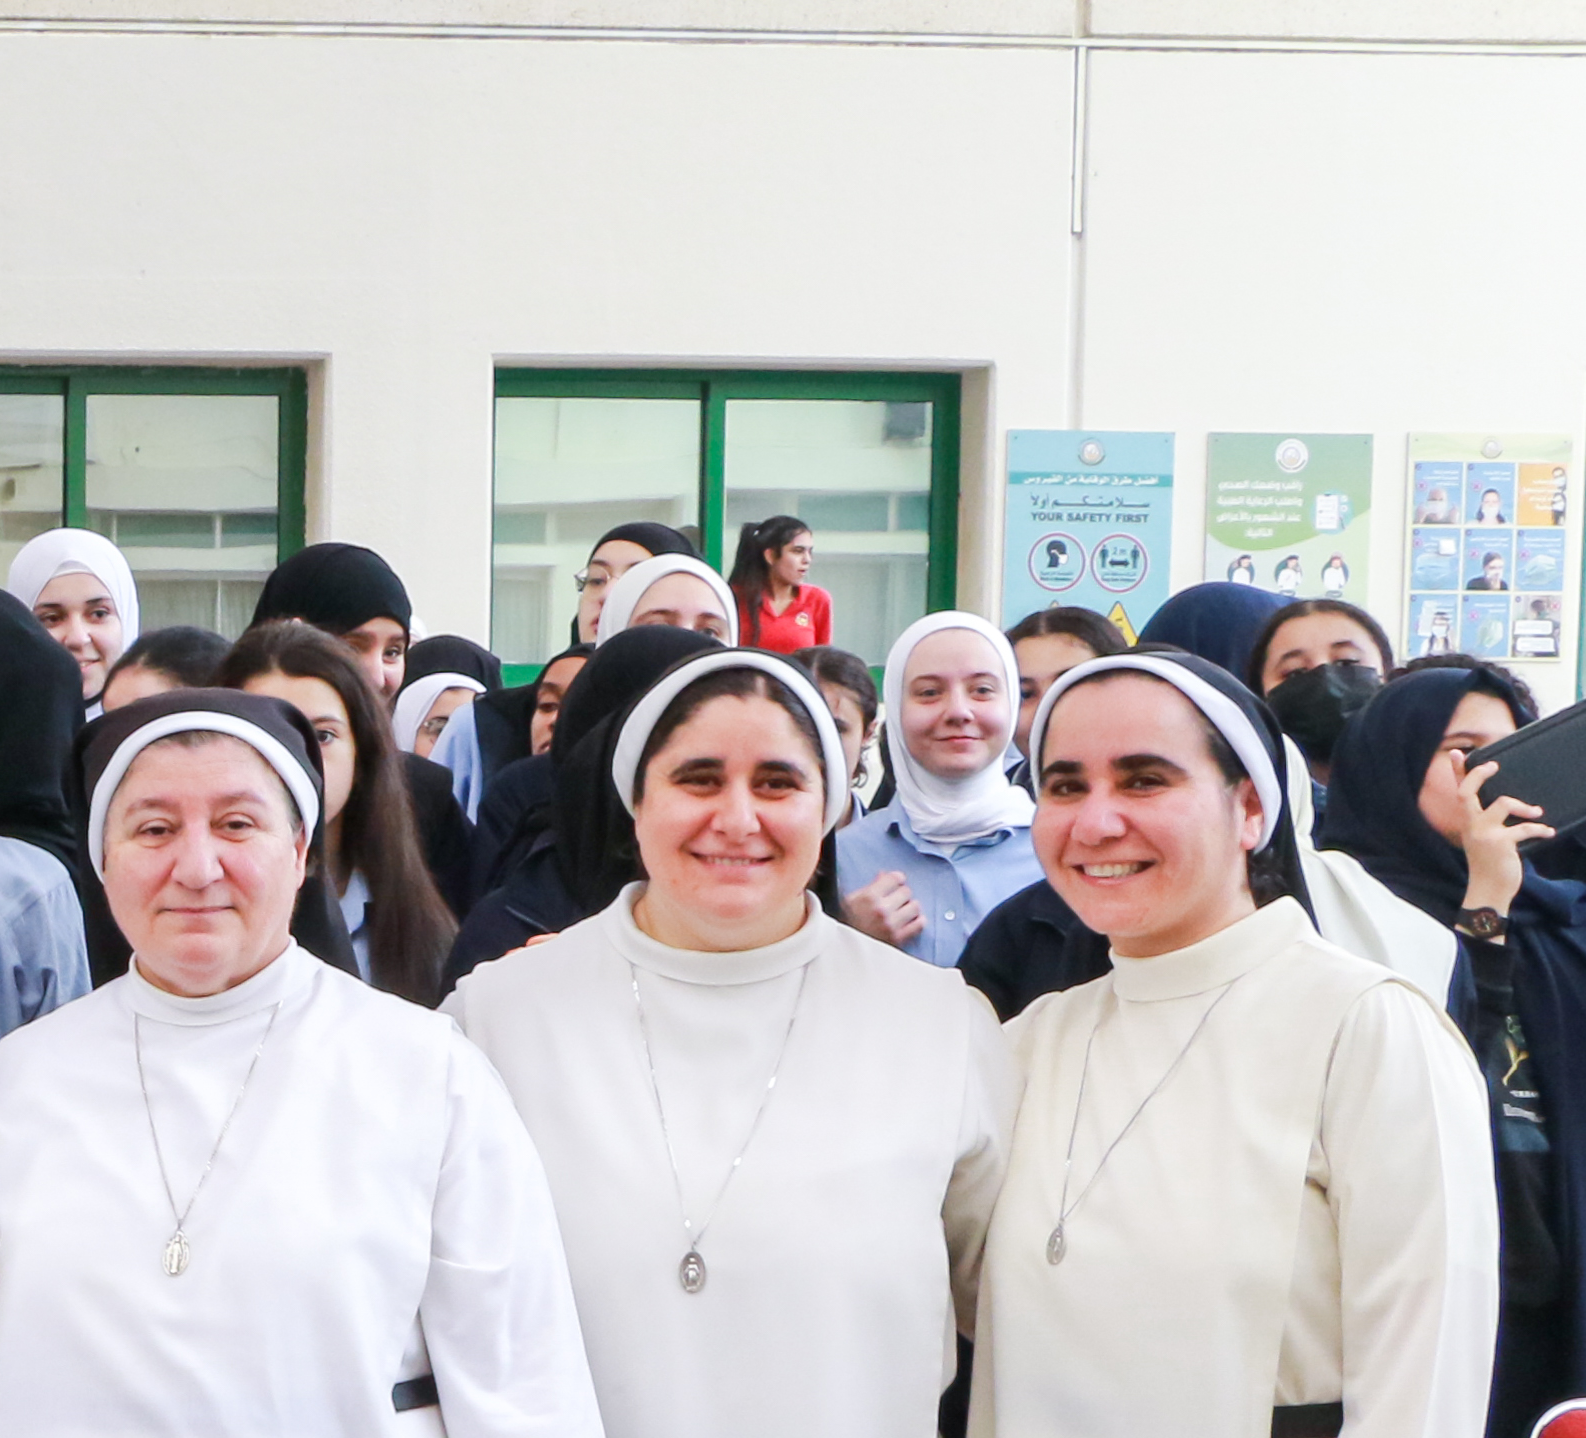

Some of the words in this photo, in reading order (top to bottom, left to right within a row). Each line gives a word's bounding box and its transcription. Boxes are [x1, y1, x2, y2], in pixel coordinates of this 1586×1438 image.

[1031, 512, 1063, 522] YOUR
[1067, 512, 1111, 523] SAFETY
[1115, 513, 1150, 523] FIRST
